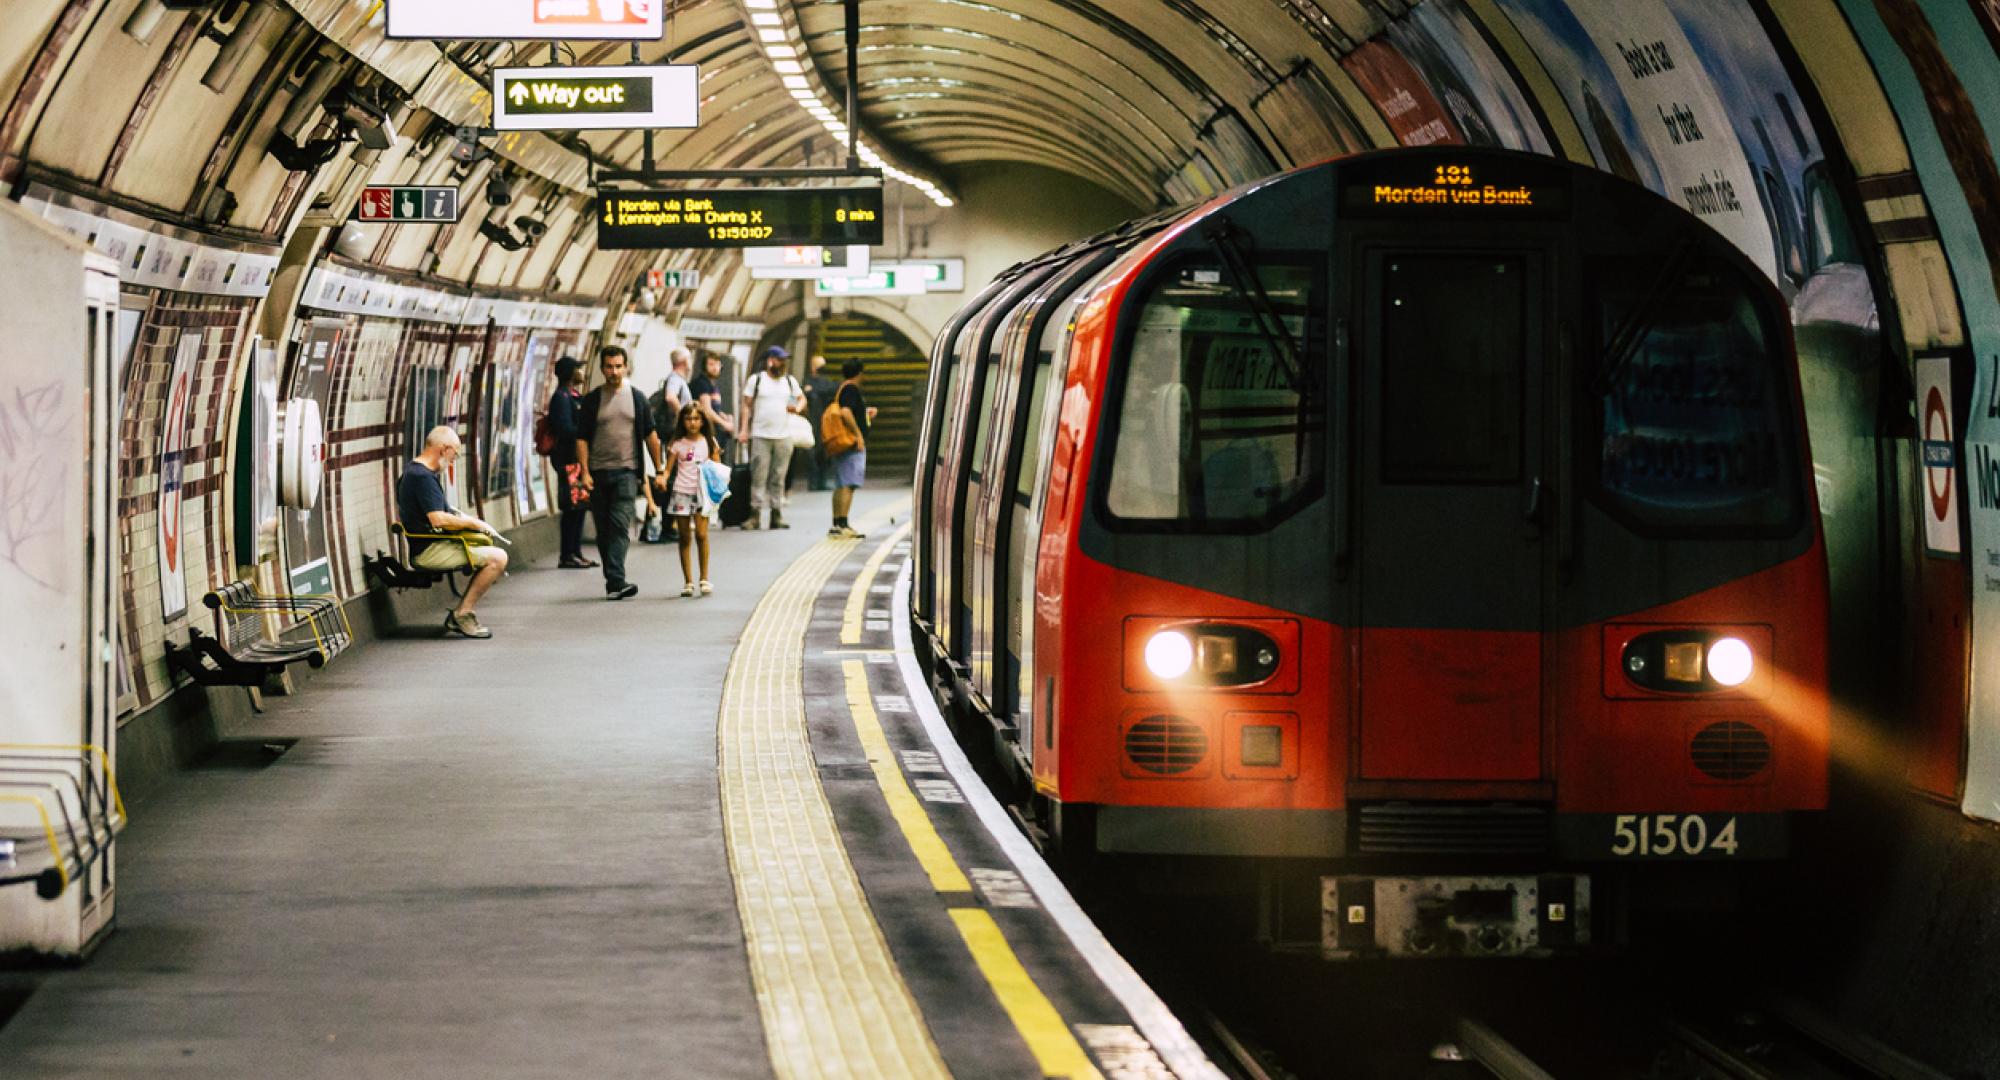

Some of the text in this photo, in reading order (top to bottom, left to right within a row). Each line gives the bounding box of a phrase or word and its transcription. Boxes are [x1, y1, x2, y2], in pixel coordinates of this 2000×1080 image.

[1616, 38, 1655, 79] Book
[1651, 40, 1676, 71] car
[532, 82, 625, 107] Way out
[1656, 102, 1705, 145] for that
[605, 197, 713, 212] 1 Morden via Bank
[1375, 185, 1532, 205] Morden via Bank
[603, 208, 875, 226] 4 Kennington via Charing X 8 mins
[708, 226, 773, 239] 13:50:07
[1612, 814, 1738, 855] 51504
